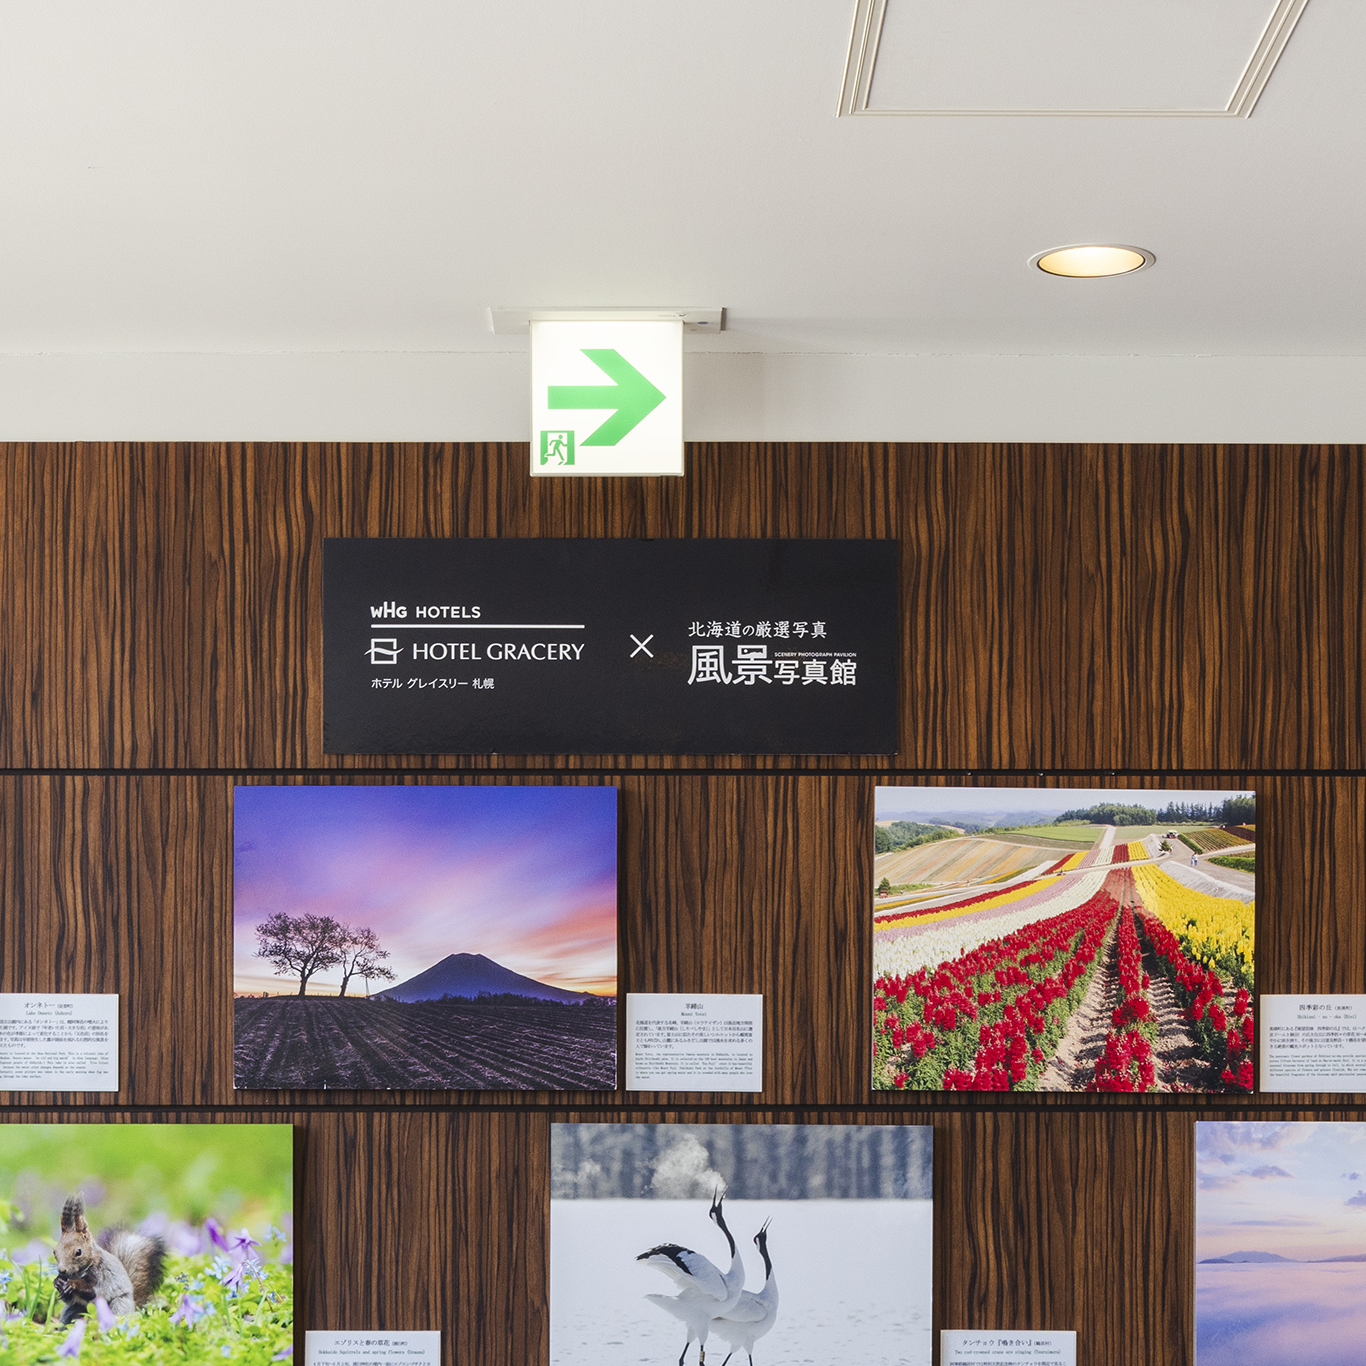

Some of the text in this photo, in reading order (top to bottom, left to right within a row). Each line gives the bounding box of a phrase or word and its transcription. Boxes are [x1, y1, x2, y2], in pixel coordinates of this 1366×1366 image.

[416, 606, 481, 619] HOTELS
[688, 620, 827, 639] 北海道の厳選写真
[413, 643, 585, 660] HOTEL GRACERY
[371, 678, 495, 689] ホテル グレイスリー 札幌
